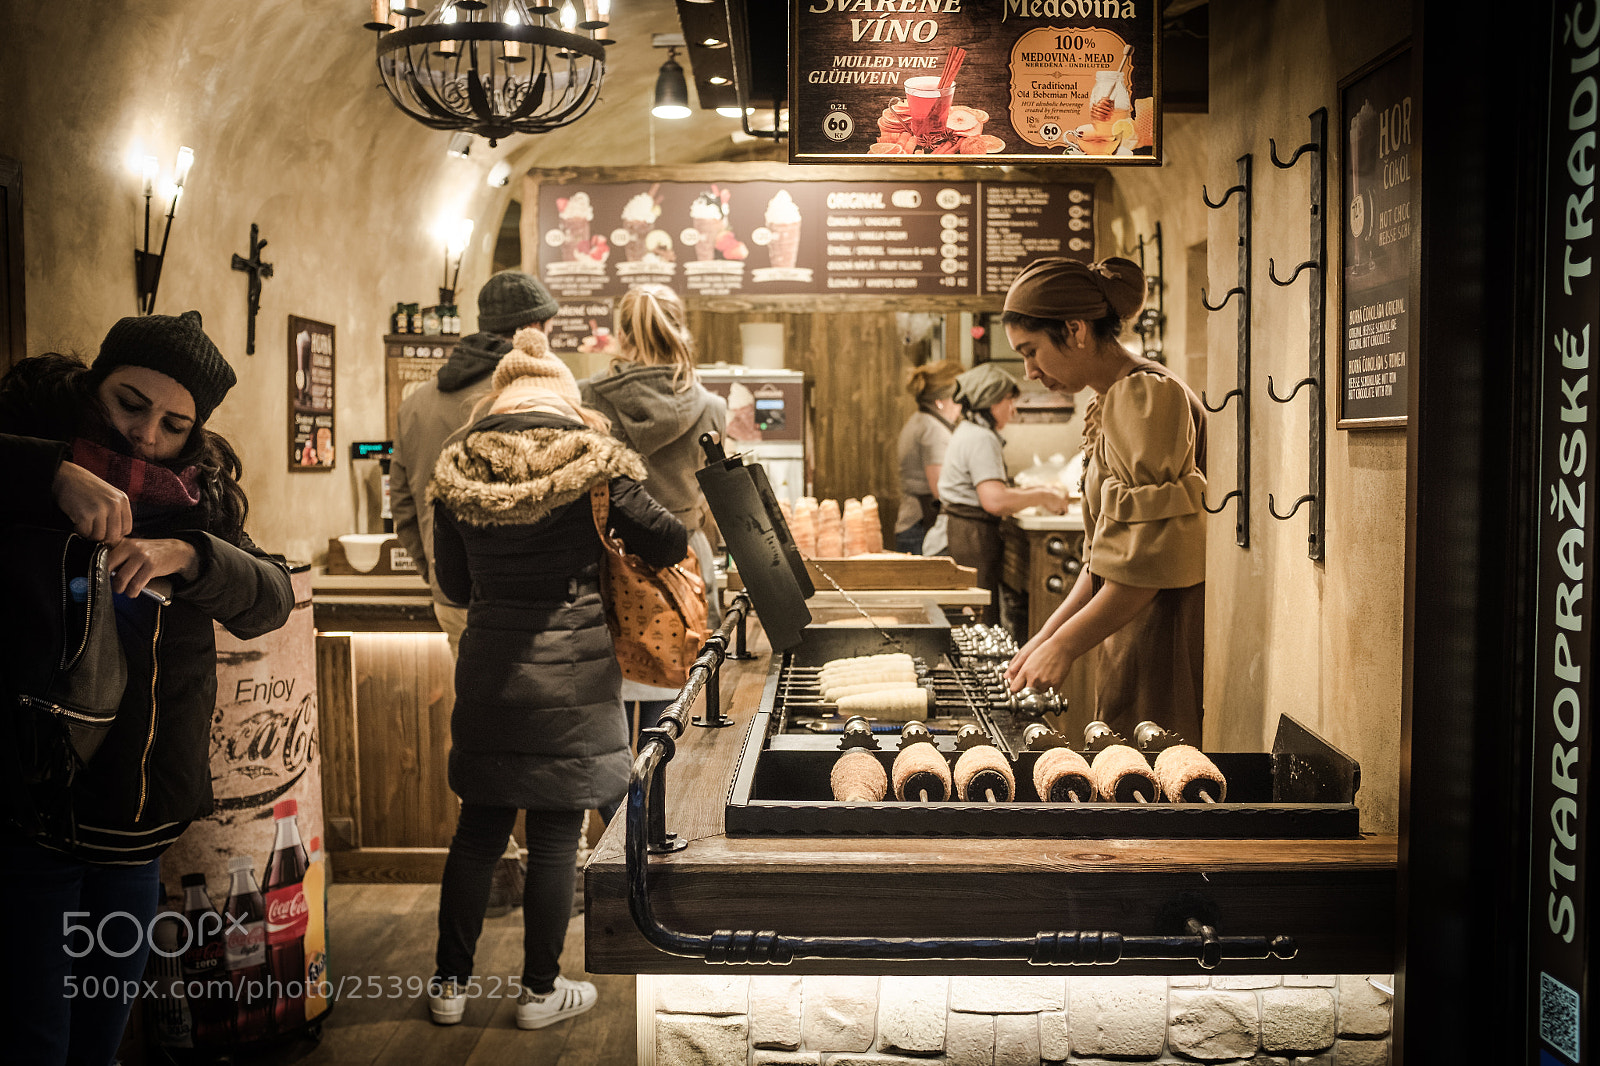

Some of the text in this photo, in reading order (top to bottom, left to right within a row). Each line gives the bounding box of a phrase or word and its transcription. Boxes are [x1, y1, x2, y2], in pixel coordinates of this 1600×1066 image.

[1001, 0, 1137, 23] Medovina
[851, 13, 939, 43] VÍNO
[1054, 35, 1096, 50] 100%
[832, 55, 939, 69] MULLED WINE
[1021, 52, 1076, 62] MEDOVINA
[1084, 53, 1114, 63] MEAD
[808, 68, 901, 85] GLÜHWEIN
[1031, 80, 1078, 90] Traditional
[1017, 90, 1089, 99] Old Bohemian Mead
[828, 118, 848, 130] 60
[1044, 126, 1058, 135] 60
[1380, 208, 1392, 230] HOT
[1548, 0, 1600, 944] STAROPRAŽSKÉ TRADIČ
[235, 676, 296, 704] Enjoy
[196, 959, 218, 968] zero
